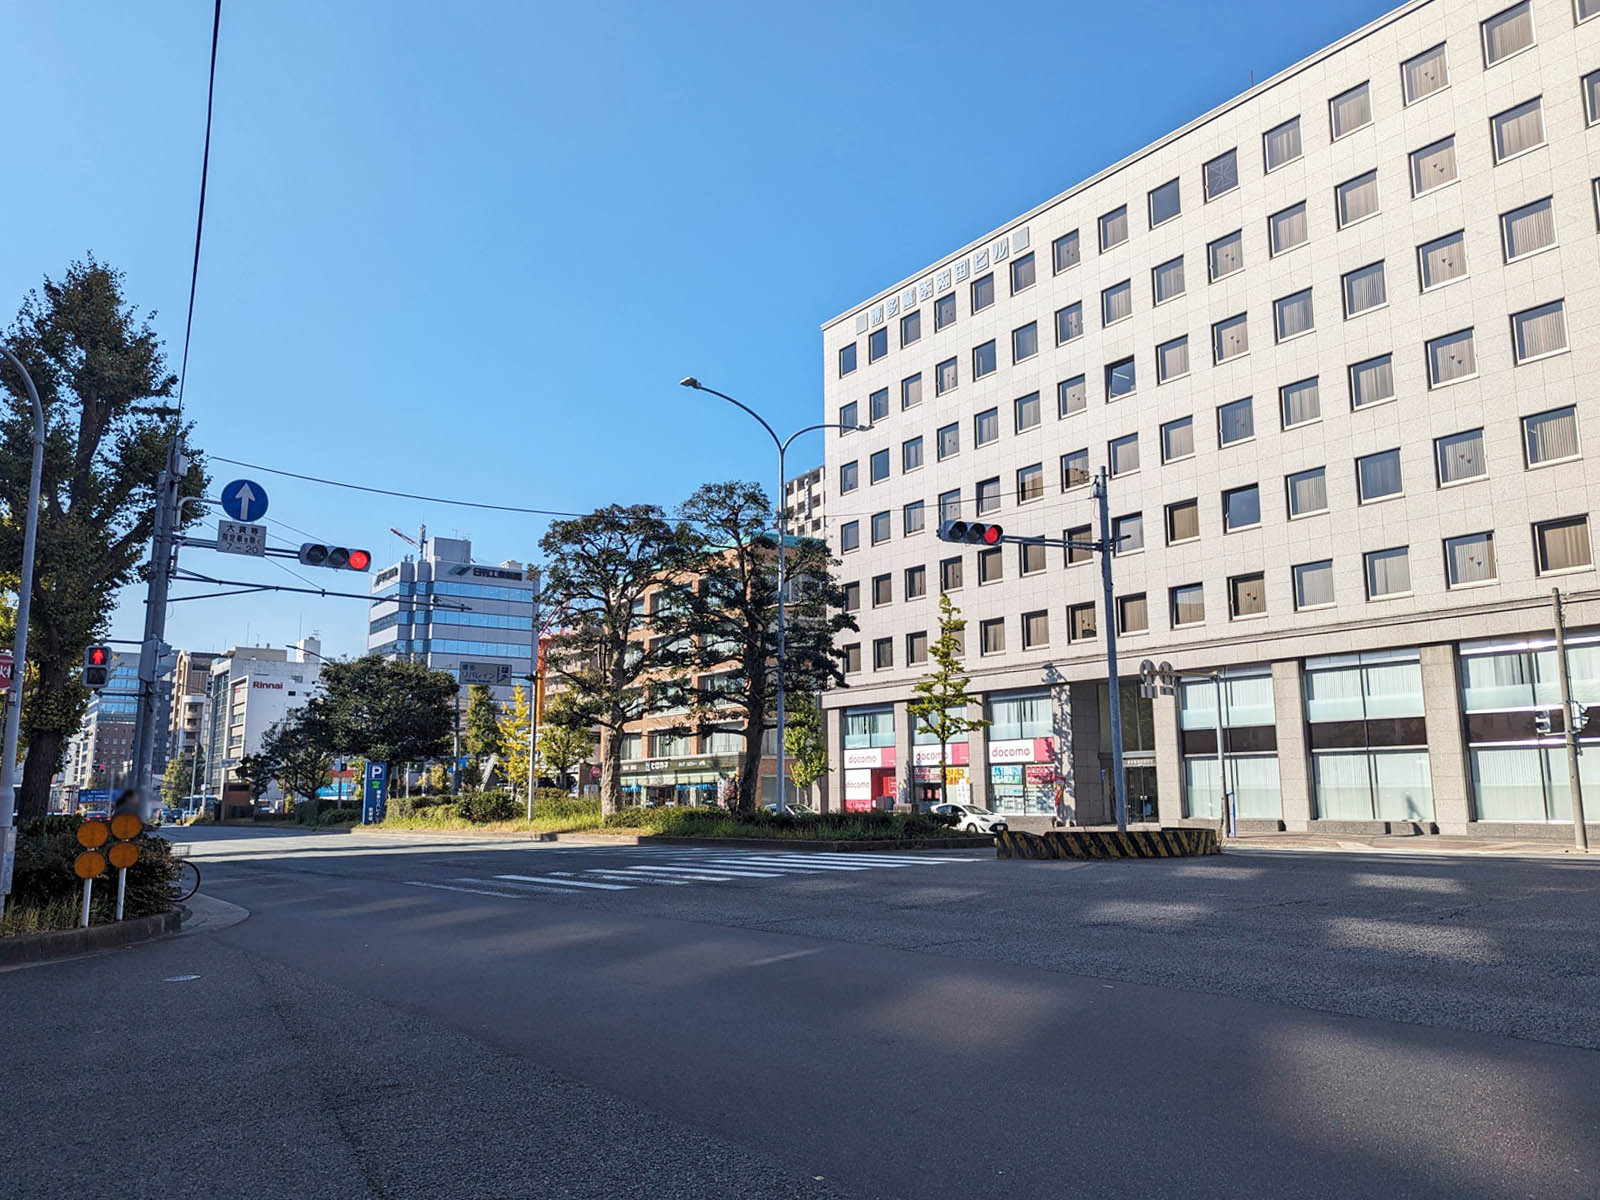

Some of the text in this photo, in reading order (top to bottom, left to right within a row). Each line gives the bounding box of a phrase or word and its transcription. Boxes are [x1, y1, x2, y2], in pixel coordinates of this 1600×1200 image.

[253, 681, 283, 689] Rinnai
[992, 747, 1030, 757] docomo
[848, 754, 877, 764] docomo
[371, 765, 382, 778] P
[846, 780, 870, 789] docomo
